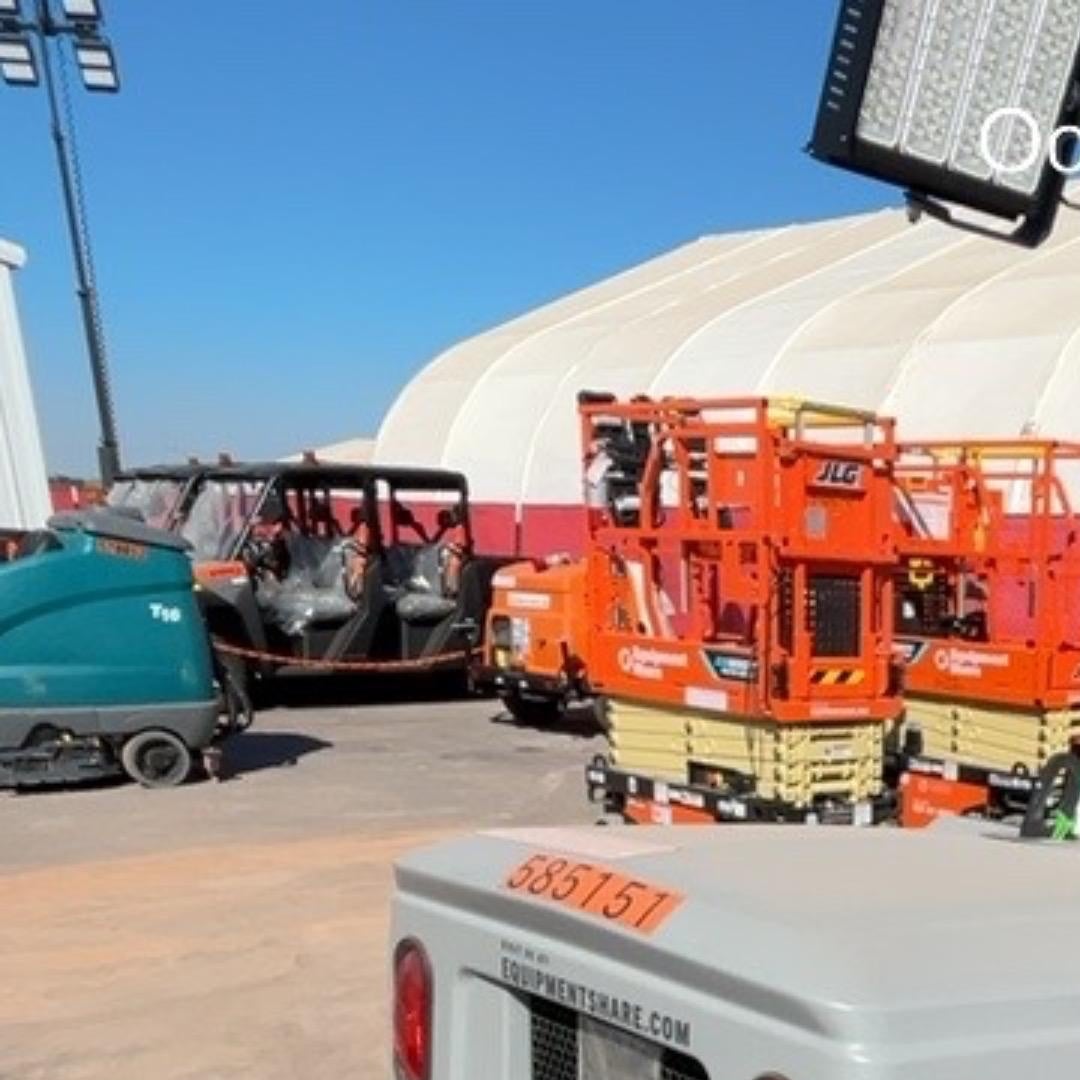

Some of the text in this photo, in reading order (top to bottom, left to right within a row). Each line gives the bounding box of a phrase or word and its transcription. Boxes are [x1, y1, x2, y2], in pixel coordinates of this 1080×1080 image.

[816, 462, 859, 484] JLG
[507, 854, 669, 927] 585151
[502, 956, 691, 1047] EQUIPMENTSHARE.COM
